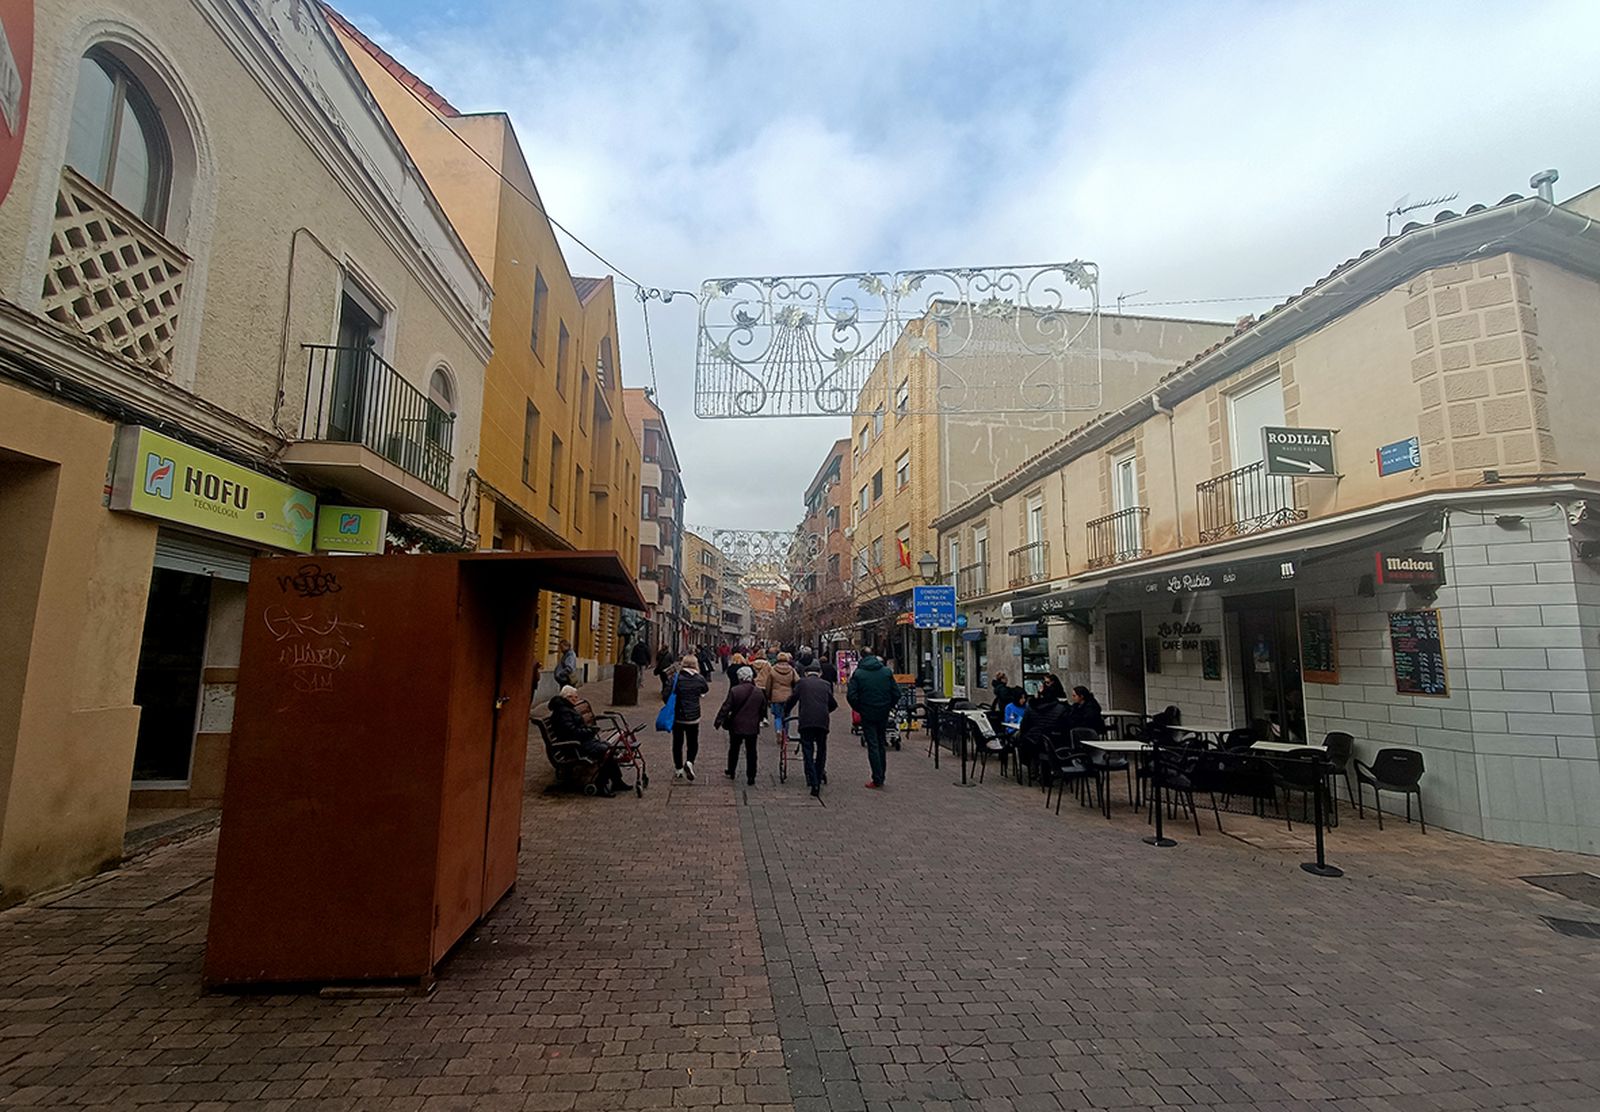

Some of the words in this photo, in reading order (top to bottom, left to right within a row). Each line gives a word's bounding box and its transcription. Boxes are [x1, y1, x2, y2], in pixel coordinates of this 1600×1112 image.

[1268, 432, 1330, 446] RODILLA
[184, 466, 250, 510] HOFU
[193, 498, 239, 519] TECNOLOGIA
[1386, 557, 1434, 571] Mahou
[1167, 575, 1182, 593] La
[1182, 573, 1212, 592] Rubia
[1222, 573, 1237, 583] BAR
[1158, 622, 1172, 637] La
[1173, 621, 1202, 637] Rubia
[1182, 640, 1199, 650] BAR
